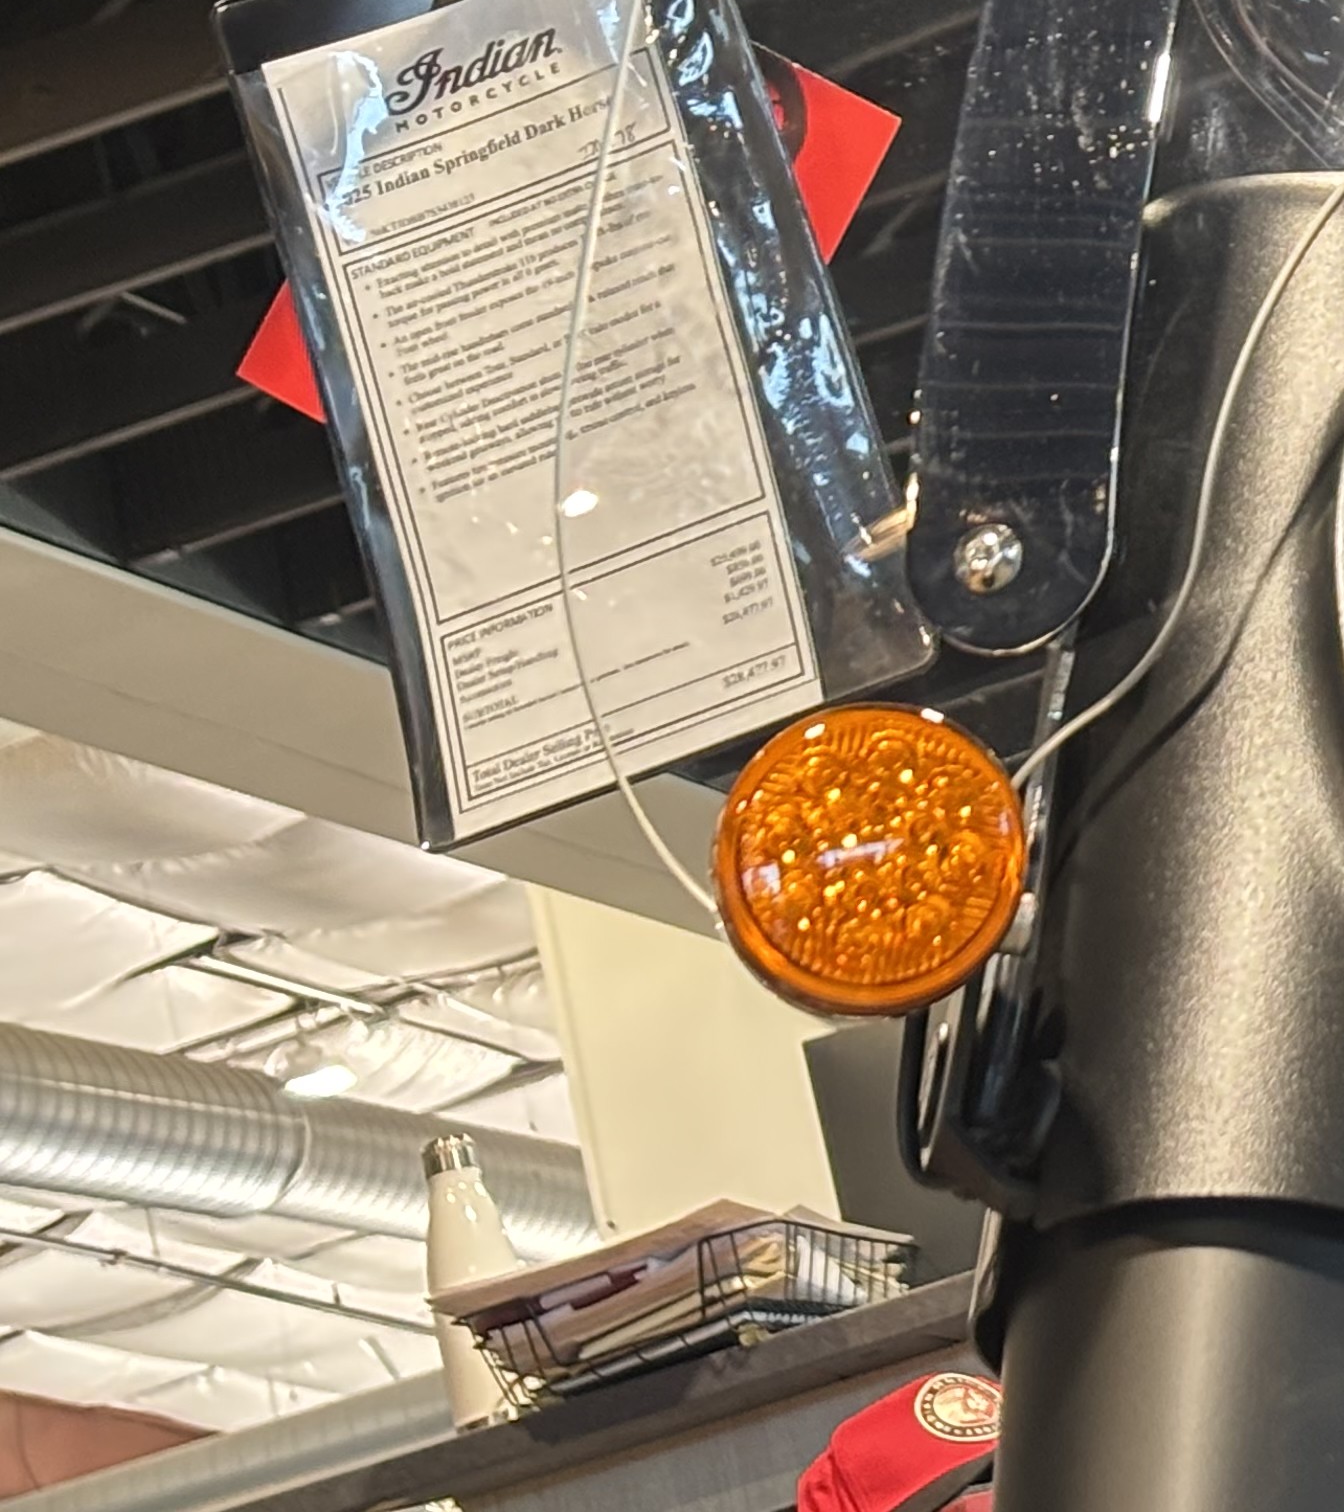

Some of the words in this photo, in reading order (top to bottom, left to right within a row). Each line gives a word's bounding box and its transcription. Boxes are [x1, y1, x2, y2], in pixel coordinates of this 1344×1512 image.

[385, 30, 559, 114] Indian
[395, 62, 558, 132] MOTORCYCLE
[375, 168, 429, 194] Indian
[433, 130, 520, 174] Springfield
[523, 114, 565, 139] Dark
